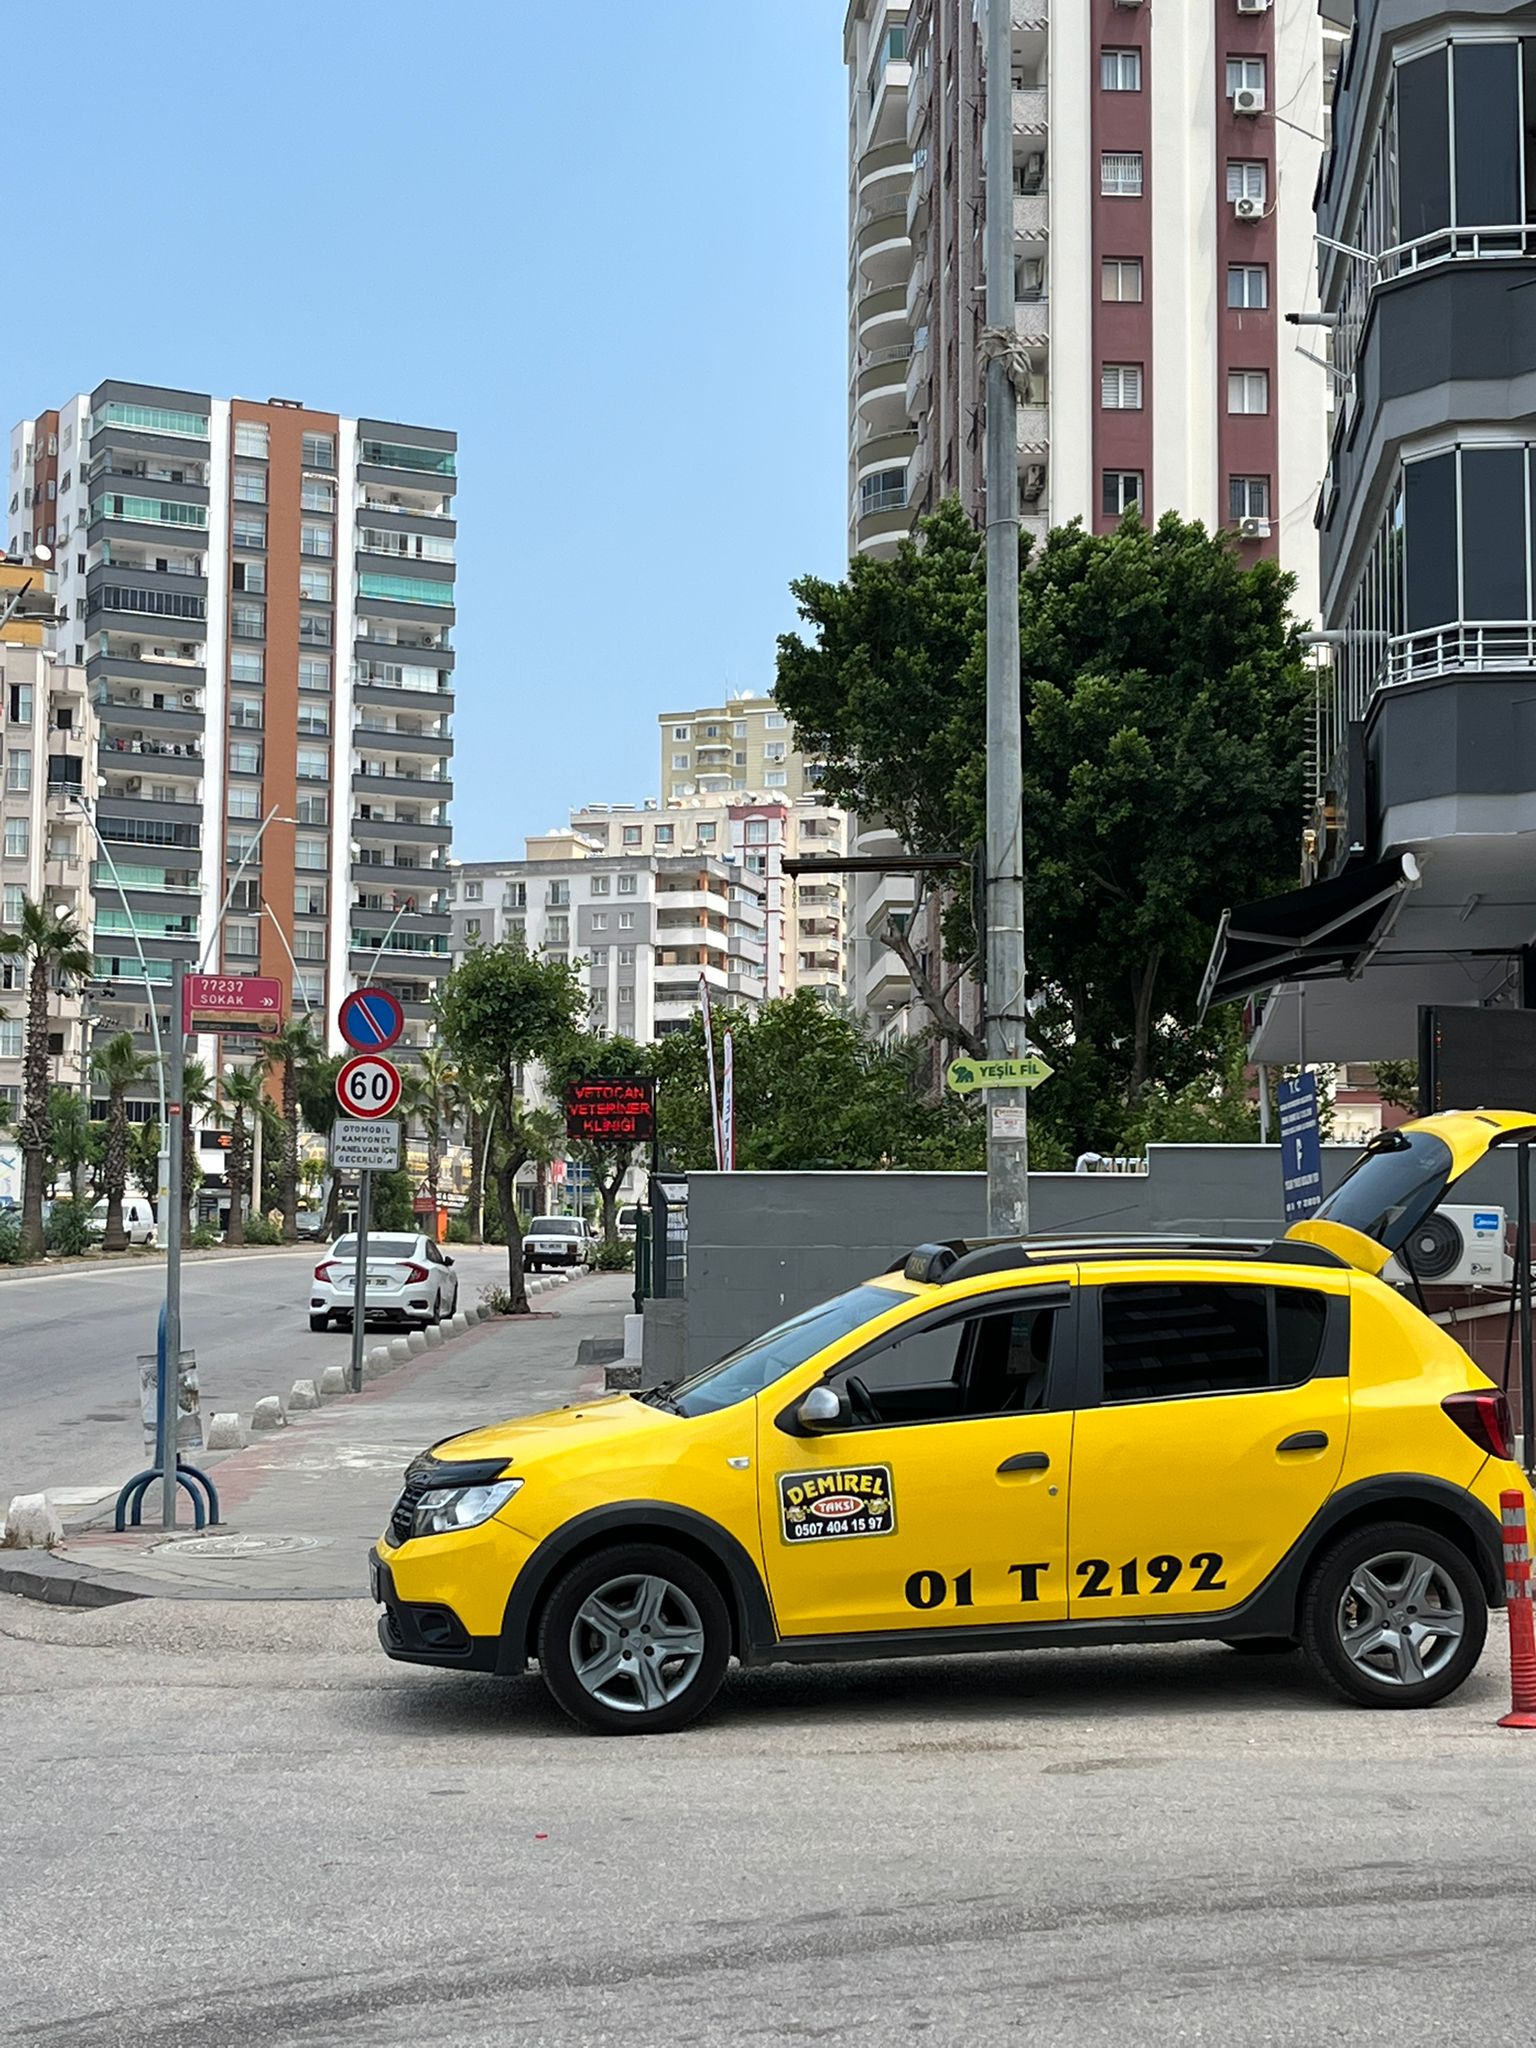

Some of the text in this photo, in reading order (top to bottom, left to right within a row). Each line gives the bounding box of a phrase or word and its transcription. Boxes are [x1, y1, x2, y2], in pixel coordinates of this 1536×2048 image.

[201, 979, 244, 992] 77237
[200, 994, 244, 1006] SOKAK
[980, 1061, 1040, 1080] YEŞİL FİL
[350, 1071, 388, 1101] 60
[343, 1125, 391, 1134] OTOMOBİL
[342, 1135, 391, 1144] KAMYONET
[336, 1145, 379, 1153] PANELVAN
[786, 1472, 884, 1505] DEMİREL
[819, 1499, 855, 1513] TAKSİ
[795, 1517, 883, 1537] 0507 404 15 97
[905, 1552, 1227, 1610] 01 T 2192
